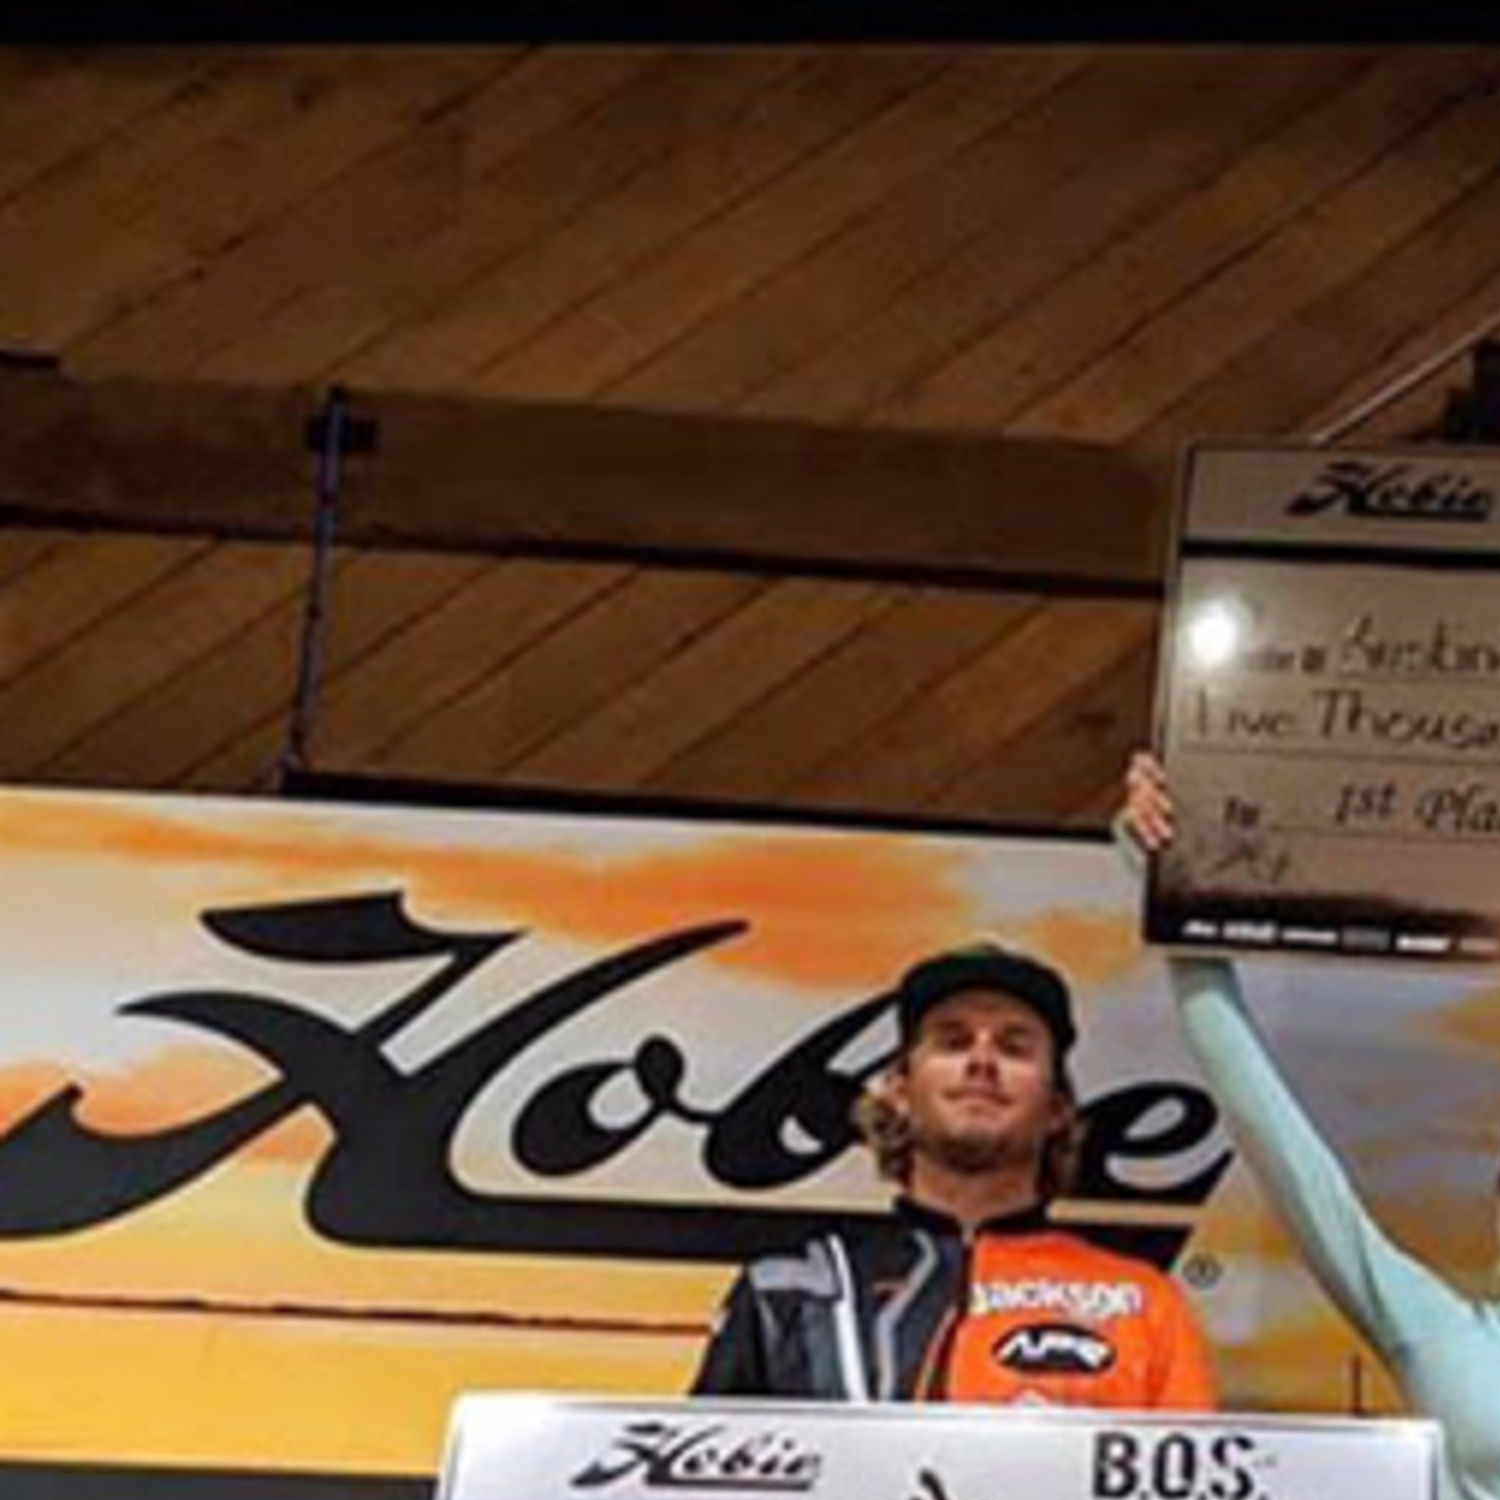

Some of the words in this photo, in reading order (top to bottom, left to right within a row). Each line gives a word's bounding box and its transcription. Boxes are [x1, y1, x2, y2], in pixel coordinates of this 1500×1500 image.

[1286, 461, 1494, 522] Hobie
[0, 892, 1234, 1270] Hobe
[570, 1422, 822, 1492] Hobie
